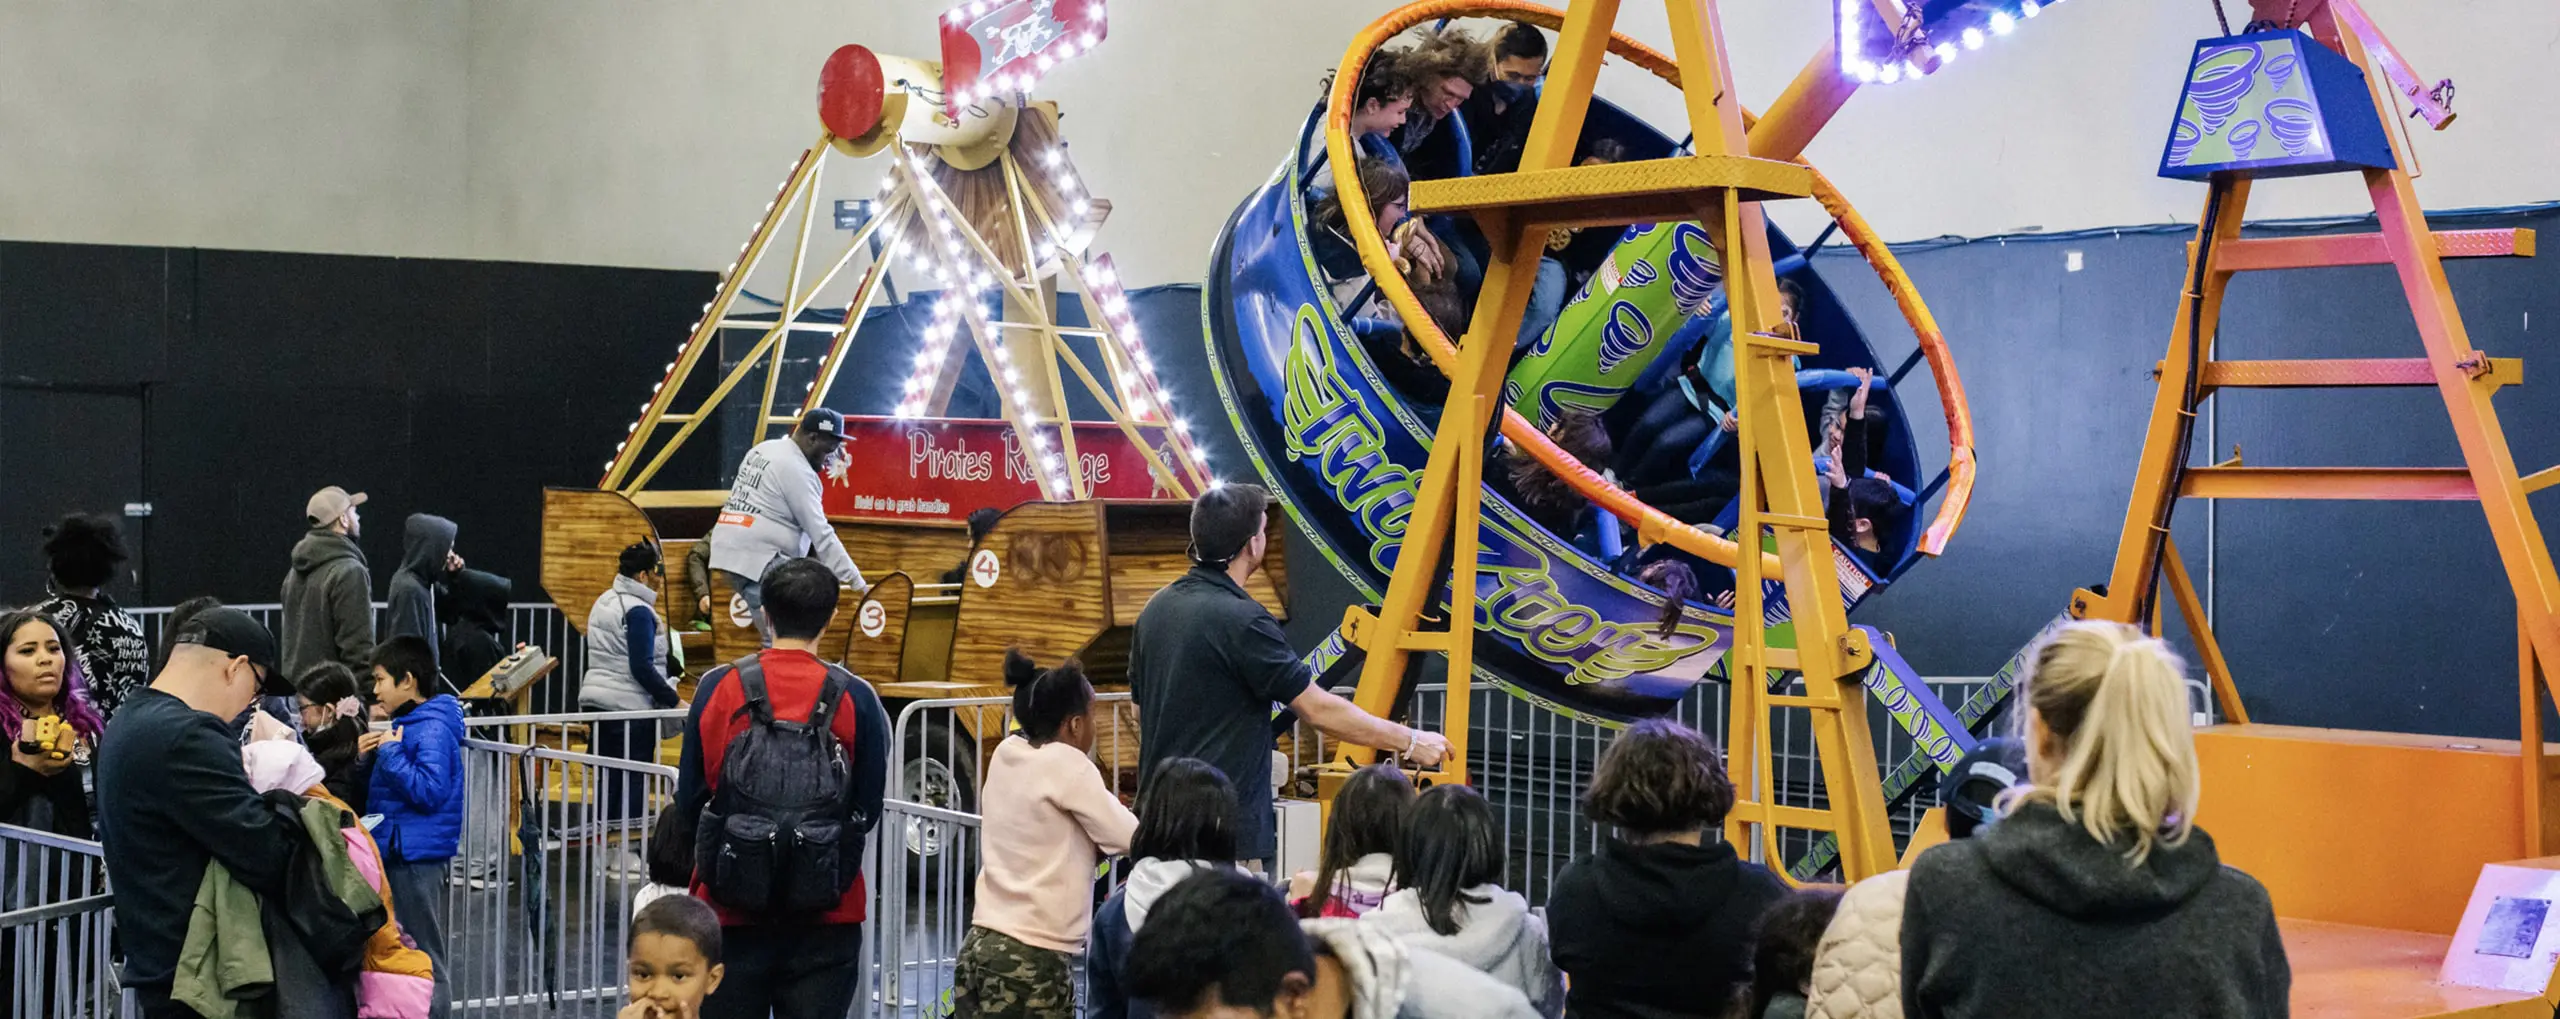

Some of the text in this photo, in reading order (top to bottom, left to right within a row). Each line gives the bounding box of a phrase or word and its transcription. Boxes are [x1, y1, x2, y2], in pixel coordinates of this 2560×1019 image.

[906, 427, 1111, 500] Pirates Reege
[854, 494, 950, 514] Hold on to grab handles
[975, 555, 997, 579] 4
[1833, 548, 1870, 587] CAUTION
[732, 598, 753, 619] 2
[862, 606, 884, 630] 3
